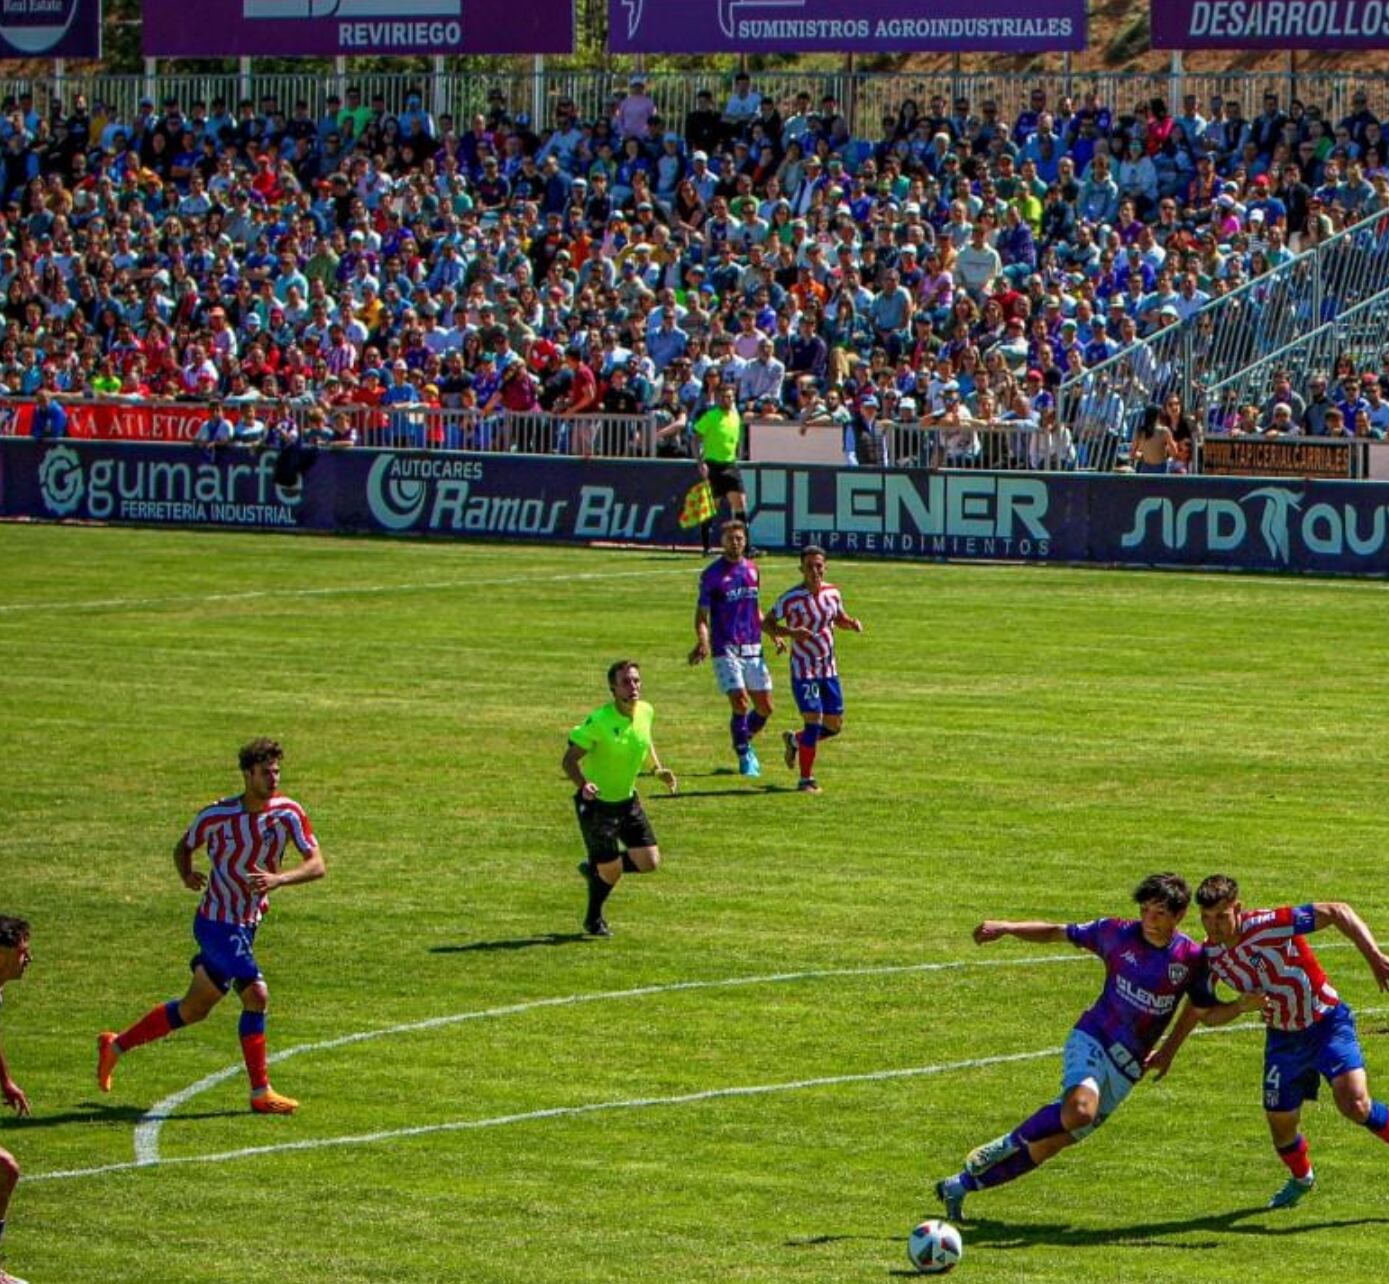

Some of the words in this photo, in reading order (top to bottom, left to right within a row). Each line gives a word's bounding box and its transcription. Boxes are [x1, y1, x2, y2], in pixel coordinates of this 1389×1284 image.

[338, 22, 461, 46] REVIRIEGO
[739, 20, 869, 38] SUMINISTROS
[875, 18, 1072, 37] AGROINDUSTRIALES
[389, 458, 483, 480] AUTOCARES
[119, 499, 207, 521] FERRETERÍA
[210, 504, 297, 525] INDUSTRIAL
[428, 480, 567, 534] Ramos
[573, 484, 664, 538] Bus
[793, 471, 1051, 540] LENER
[791, 529, 1050, 557] EMPRENDIMIENTOS
[1266, 1064, 1280, 1089] 4
